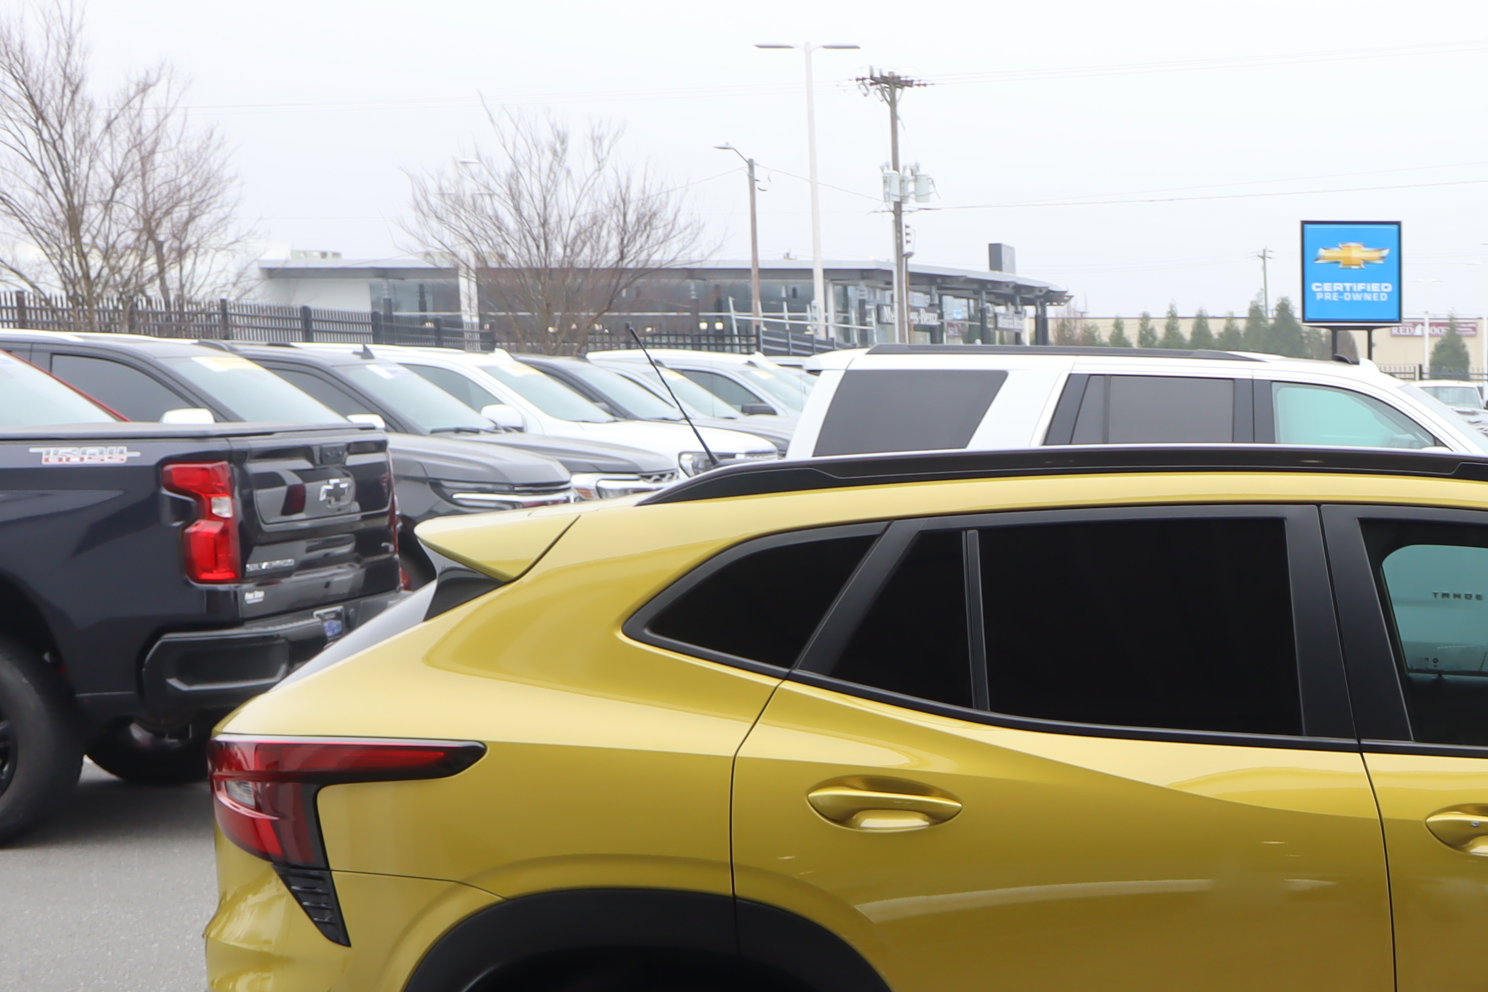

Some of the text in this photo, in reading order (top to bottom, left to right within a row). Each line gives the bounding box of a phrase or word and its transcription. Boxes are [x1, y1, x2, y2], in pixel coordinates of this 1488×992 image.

[1311, 282, 1393, 292] CERTIFIED
[1315, 292, 1389, 302] PRE-OWNED
[1391, 325, 1413, 336] RED
[1432, 591, 1483, 601] TAHOE
